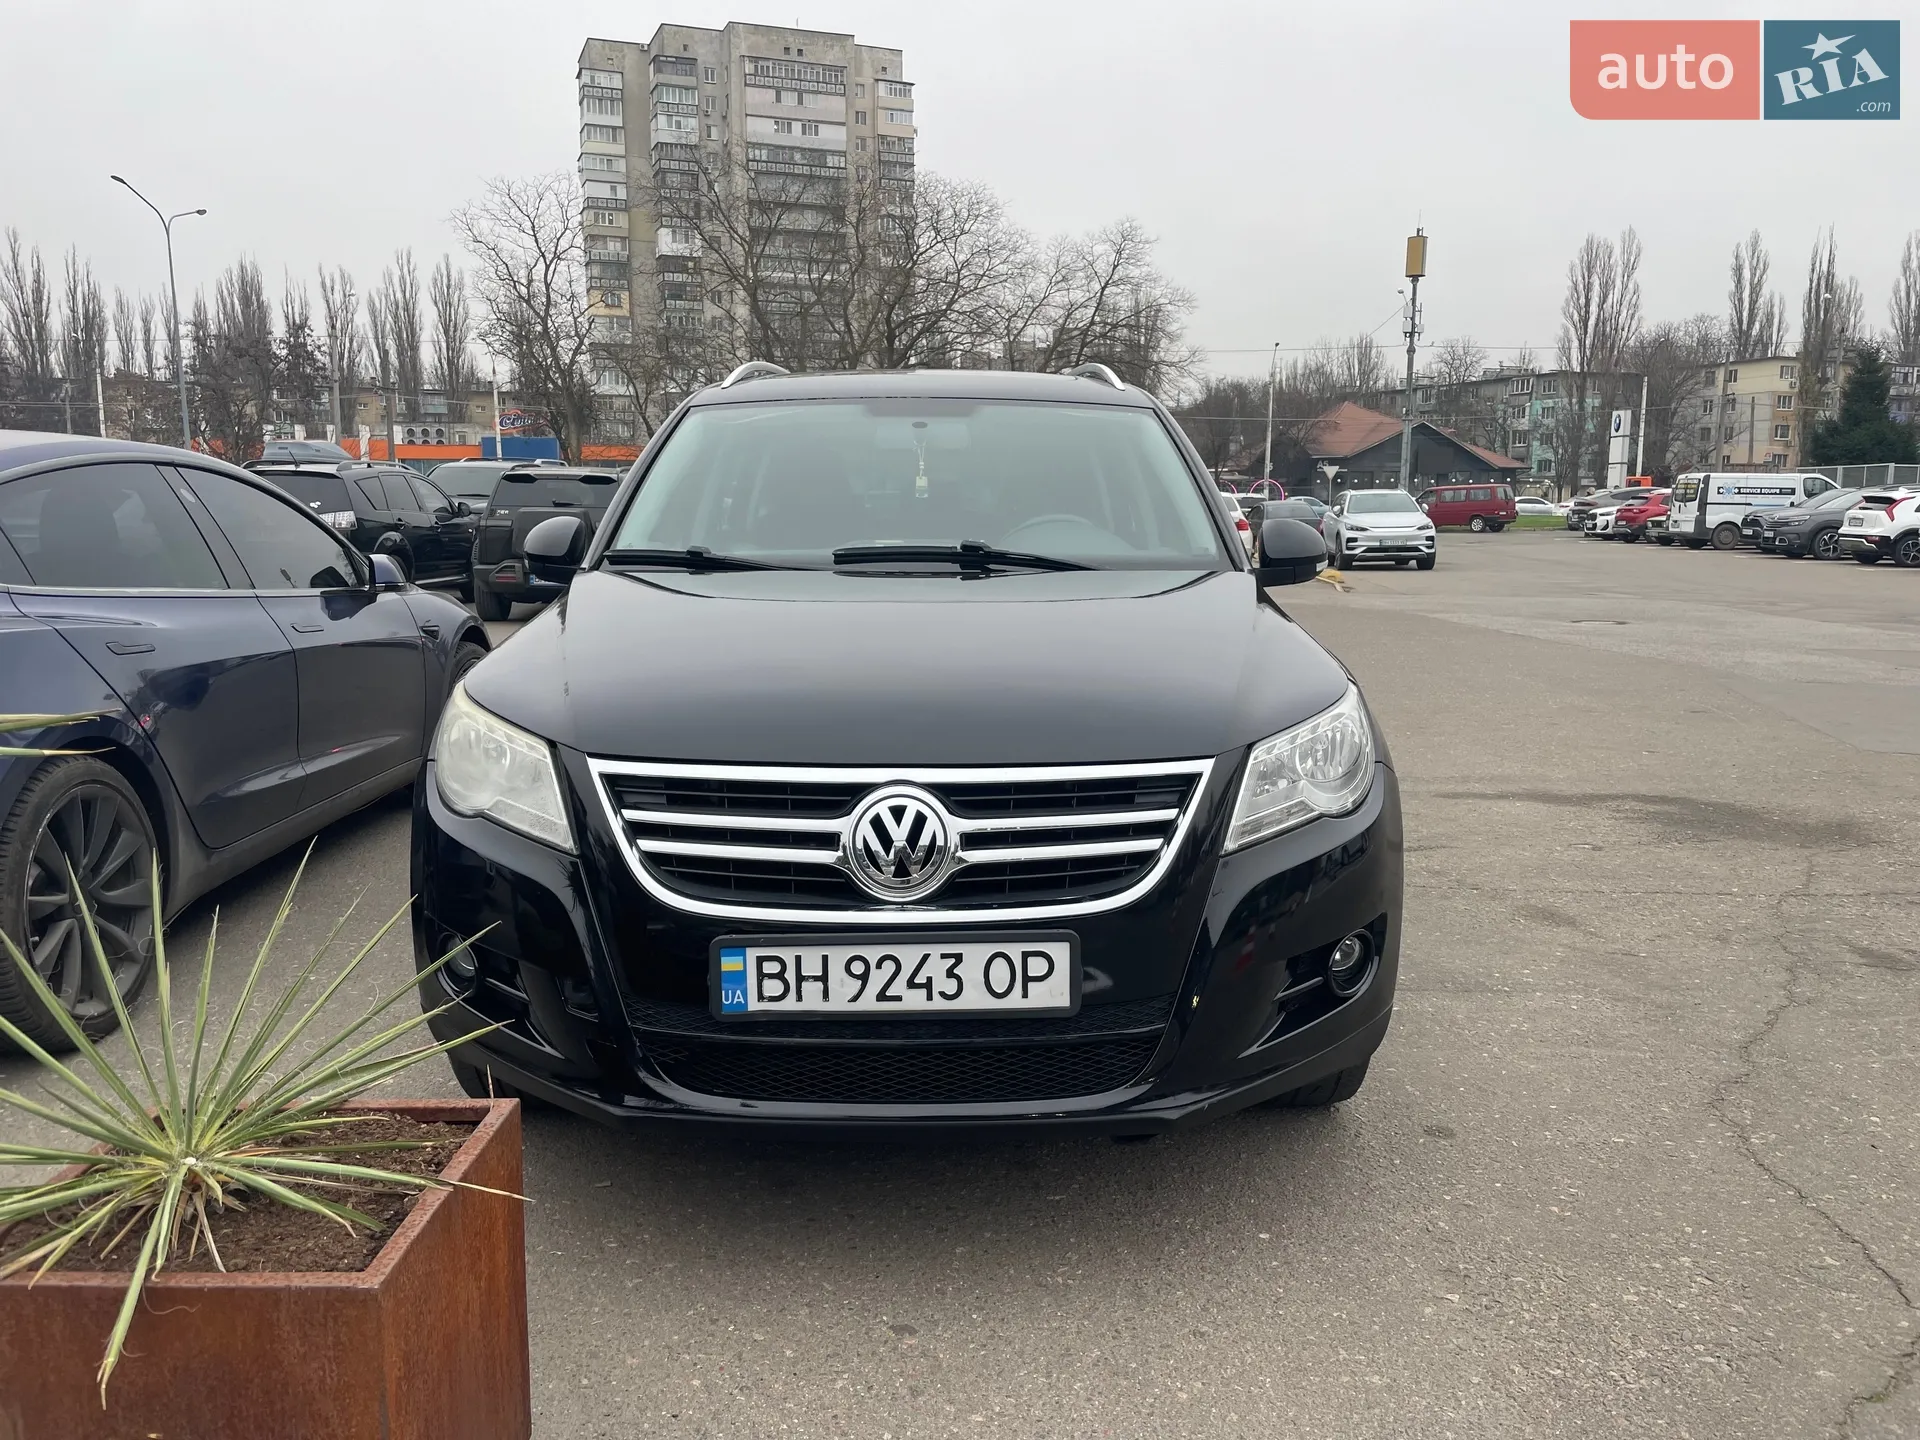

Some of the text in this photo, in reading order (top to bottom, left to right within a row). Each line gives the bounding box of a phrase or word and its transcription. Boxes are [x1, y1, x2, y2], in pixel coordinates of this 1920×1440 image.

[755, 949, 1055, 1003] BH 9243 OP
[721, 989, 745, 1005] UA
